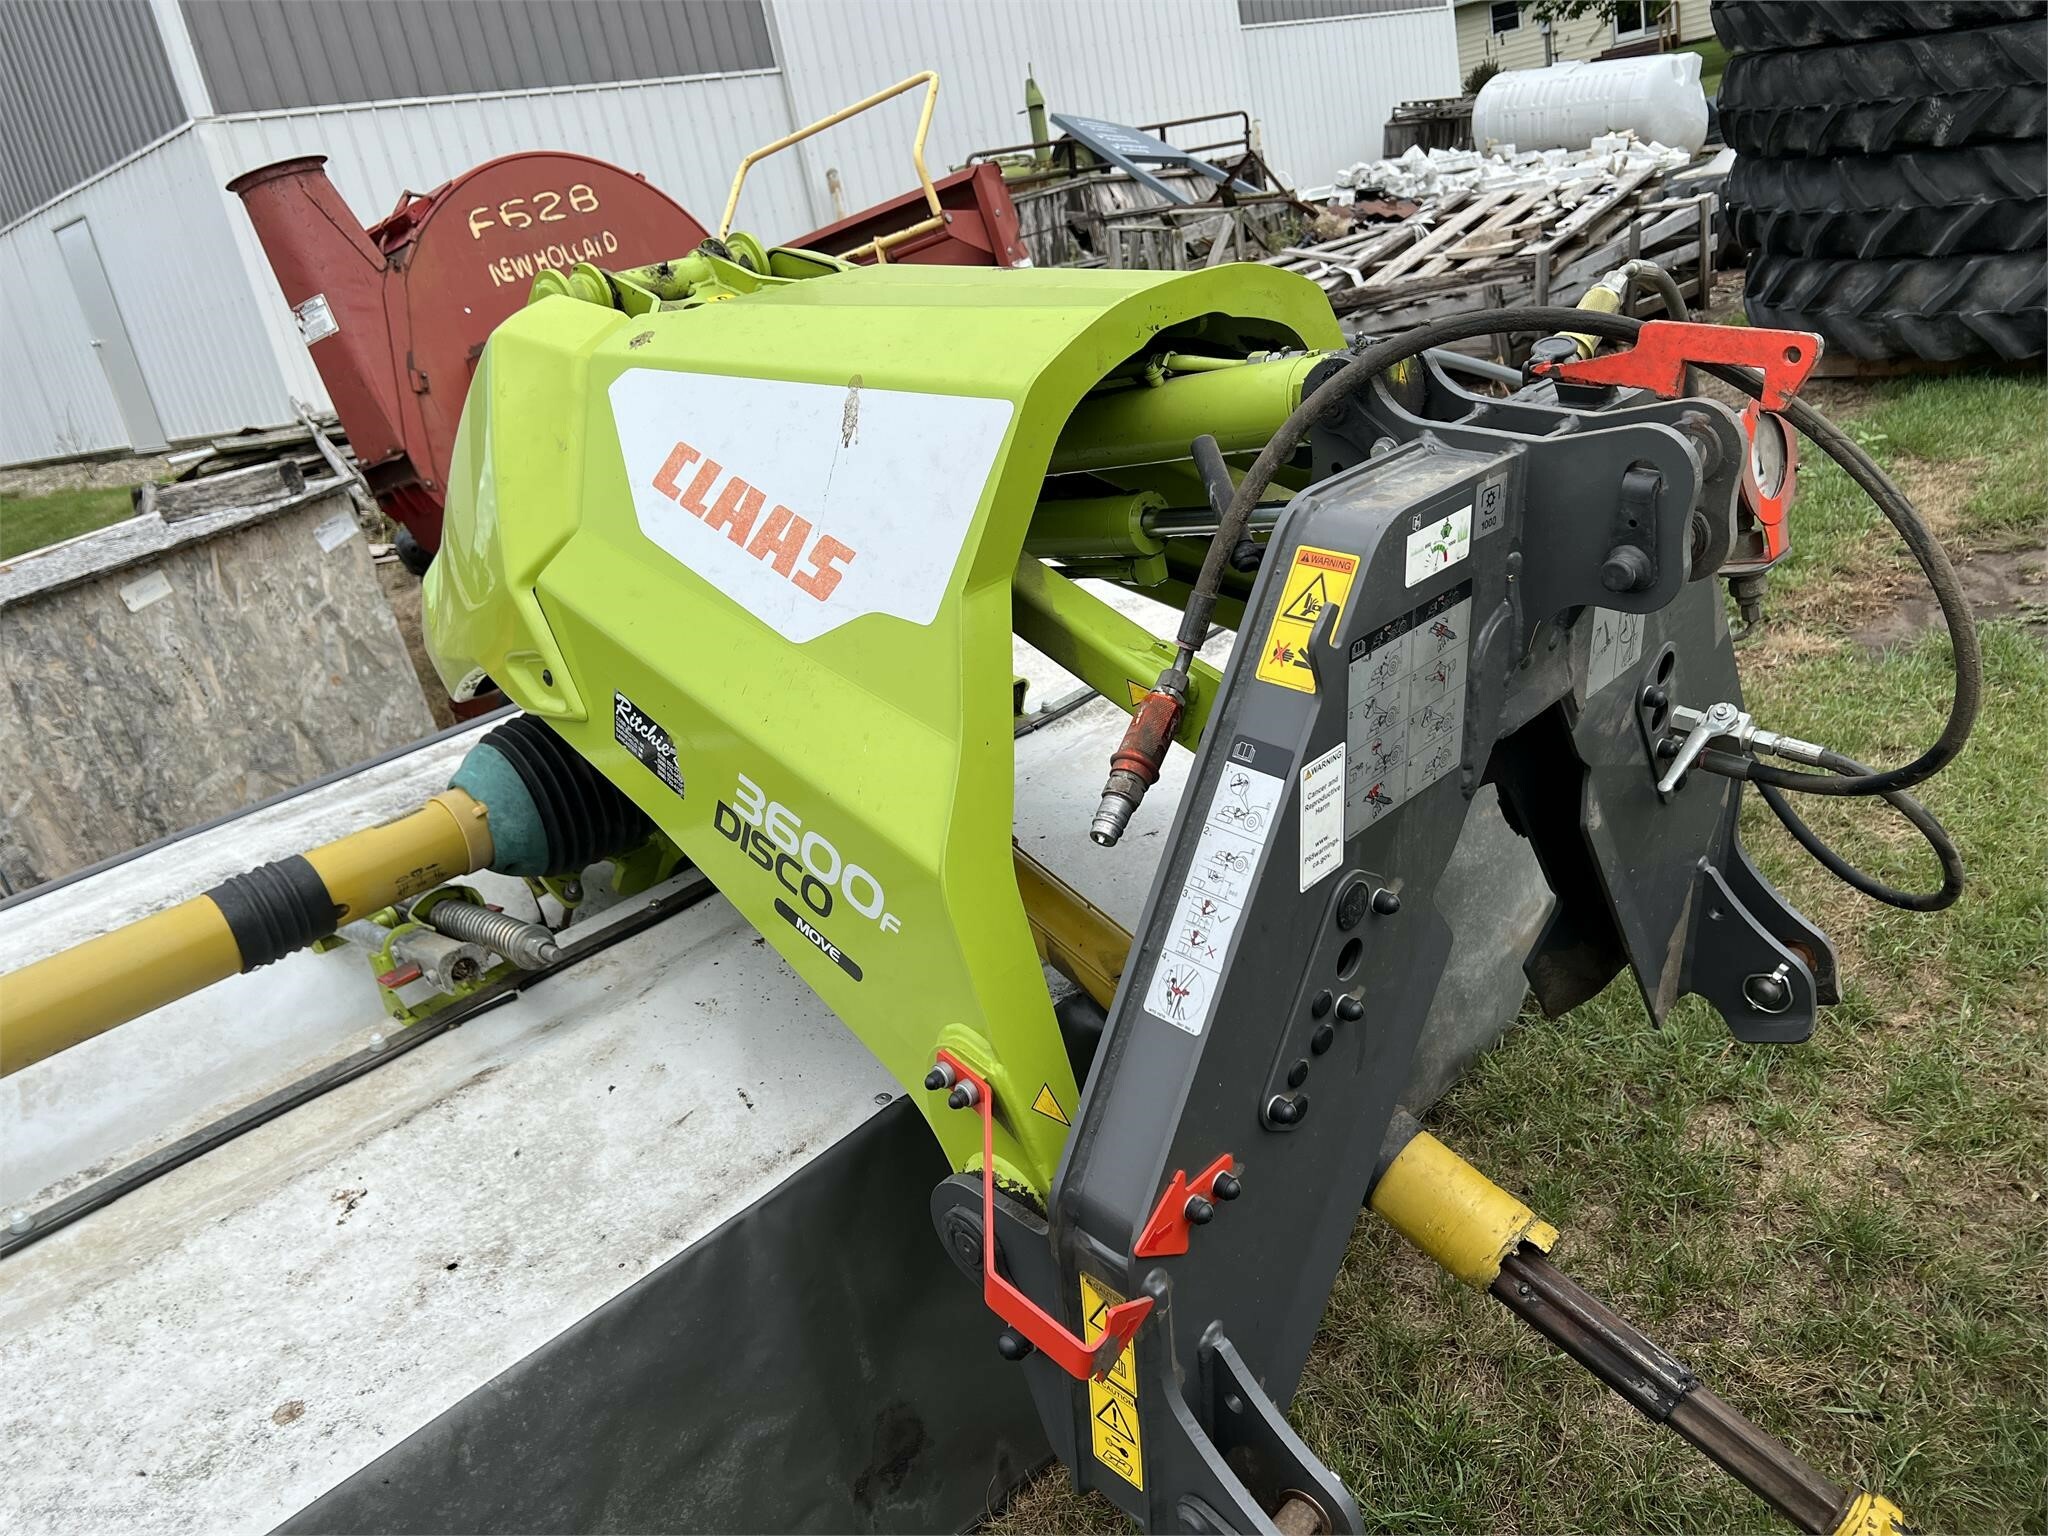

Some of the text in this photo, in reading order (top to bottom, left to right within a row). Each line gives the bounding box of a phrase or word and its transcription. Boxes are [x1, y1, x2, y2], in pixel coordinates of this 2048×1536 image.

[468, 184, 599, 239] F628
[488, 254, 534, 287] NEW
[652, 440, 857, 602] CLAAS
[1310, 555, 1352, 570] WARNING
[615, 693, 670, 756] Ritchie
[1311, 750, 1342, 775] WARNING
[1304, 784, 1341, 812] Reproductive
[1307, 775, 1339, 800] Cancer and
[1315, 801, 1331, 815] Harm
[713, 799, 833, 918] DISCO
[795, 916, 841, 963] MOVE
[1102, 1381, 1134, 1408] CAUTION
